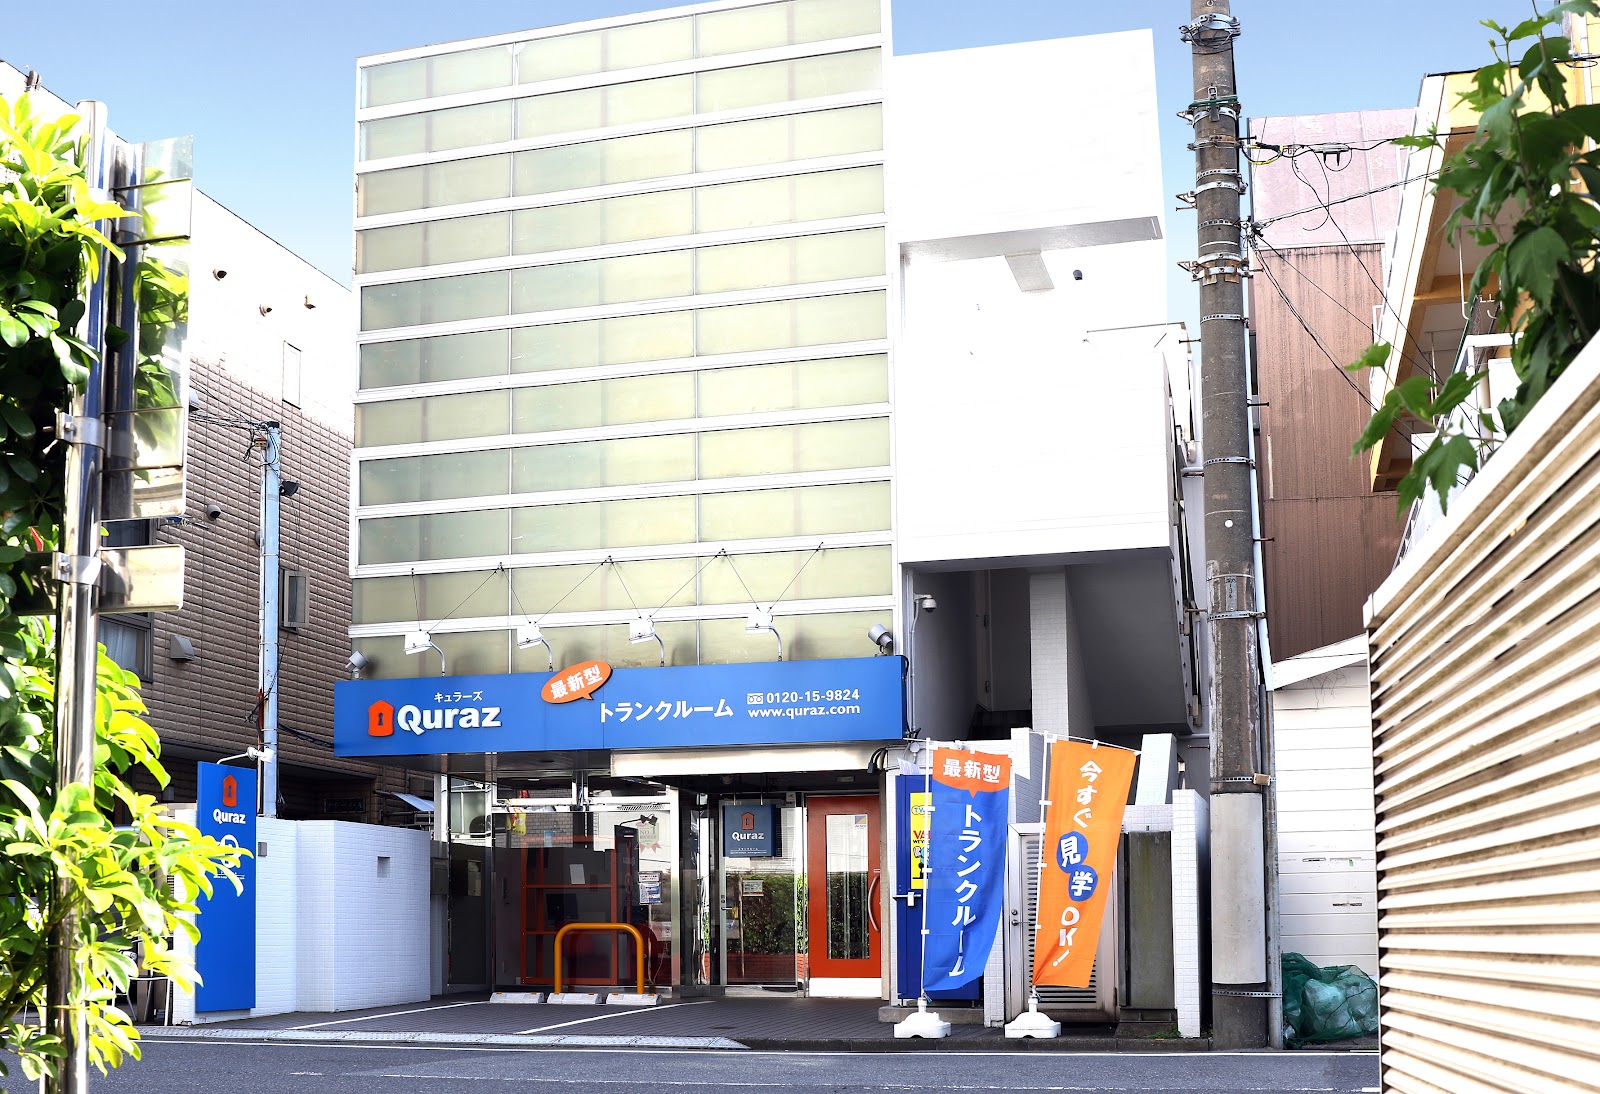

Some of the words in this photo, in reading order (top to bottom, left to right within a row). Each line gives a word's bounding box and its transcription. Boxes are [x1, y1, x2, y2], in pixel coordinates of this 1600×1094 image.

[550, 664, 603, 700] 最新型
[433, 690, 483, 703] キュラーズ
[766, 688, 860, 704] 0120-15-9824
[397, 704, 502, 735] Quraz
[600, 698, 734, 723] トランクルーム
[747, 704, 861, 720] www.quraz.com
[942, 757, 1001, 784] 最新型
[213, 808, 246, 825] Quraz
[731, 831, 765, 842] Quraz
[948, 803, 983, 977] トランクルーム
